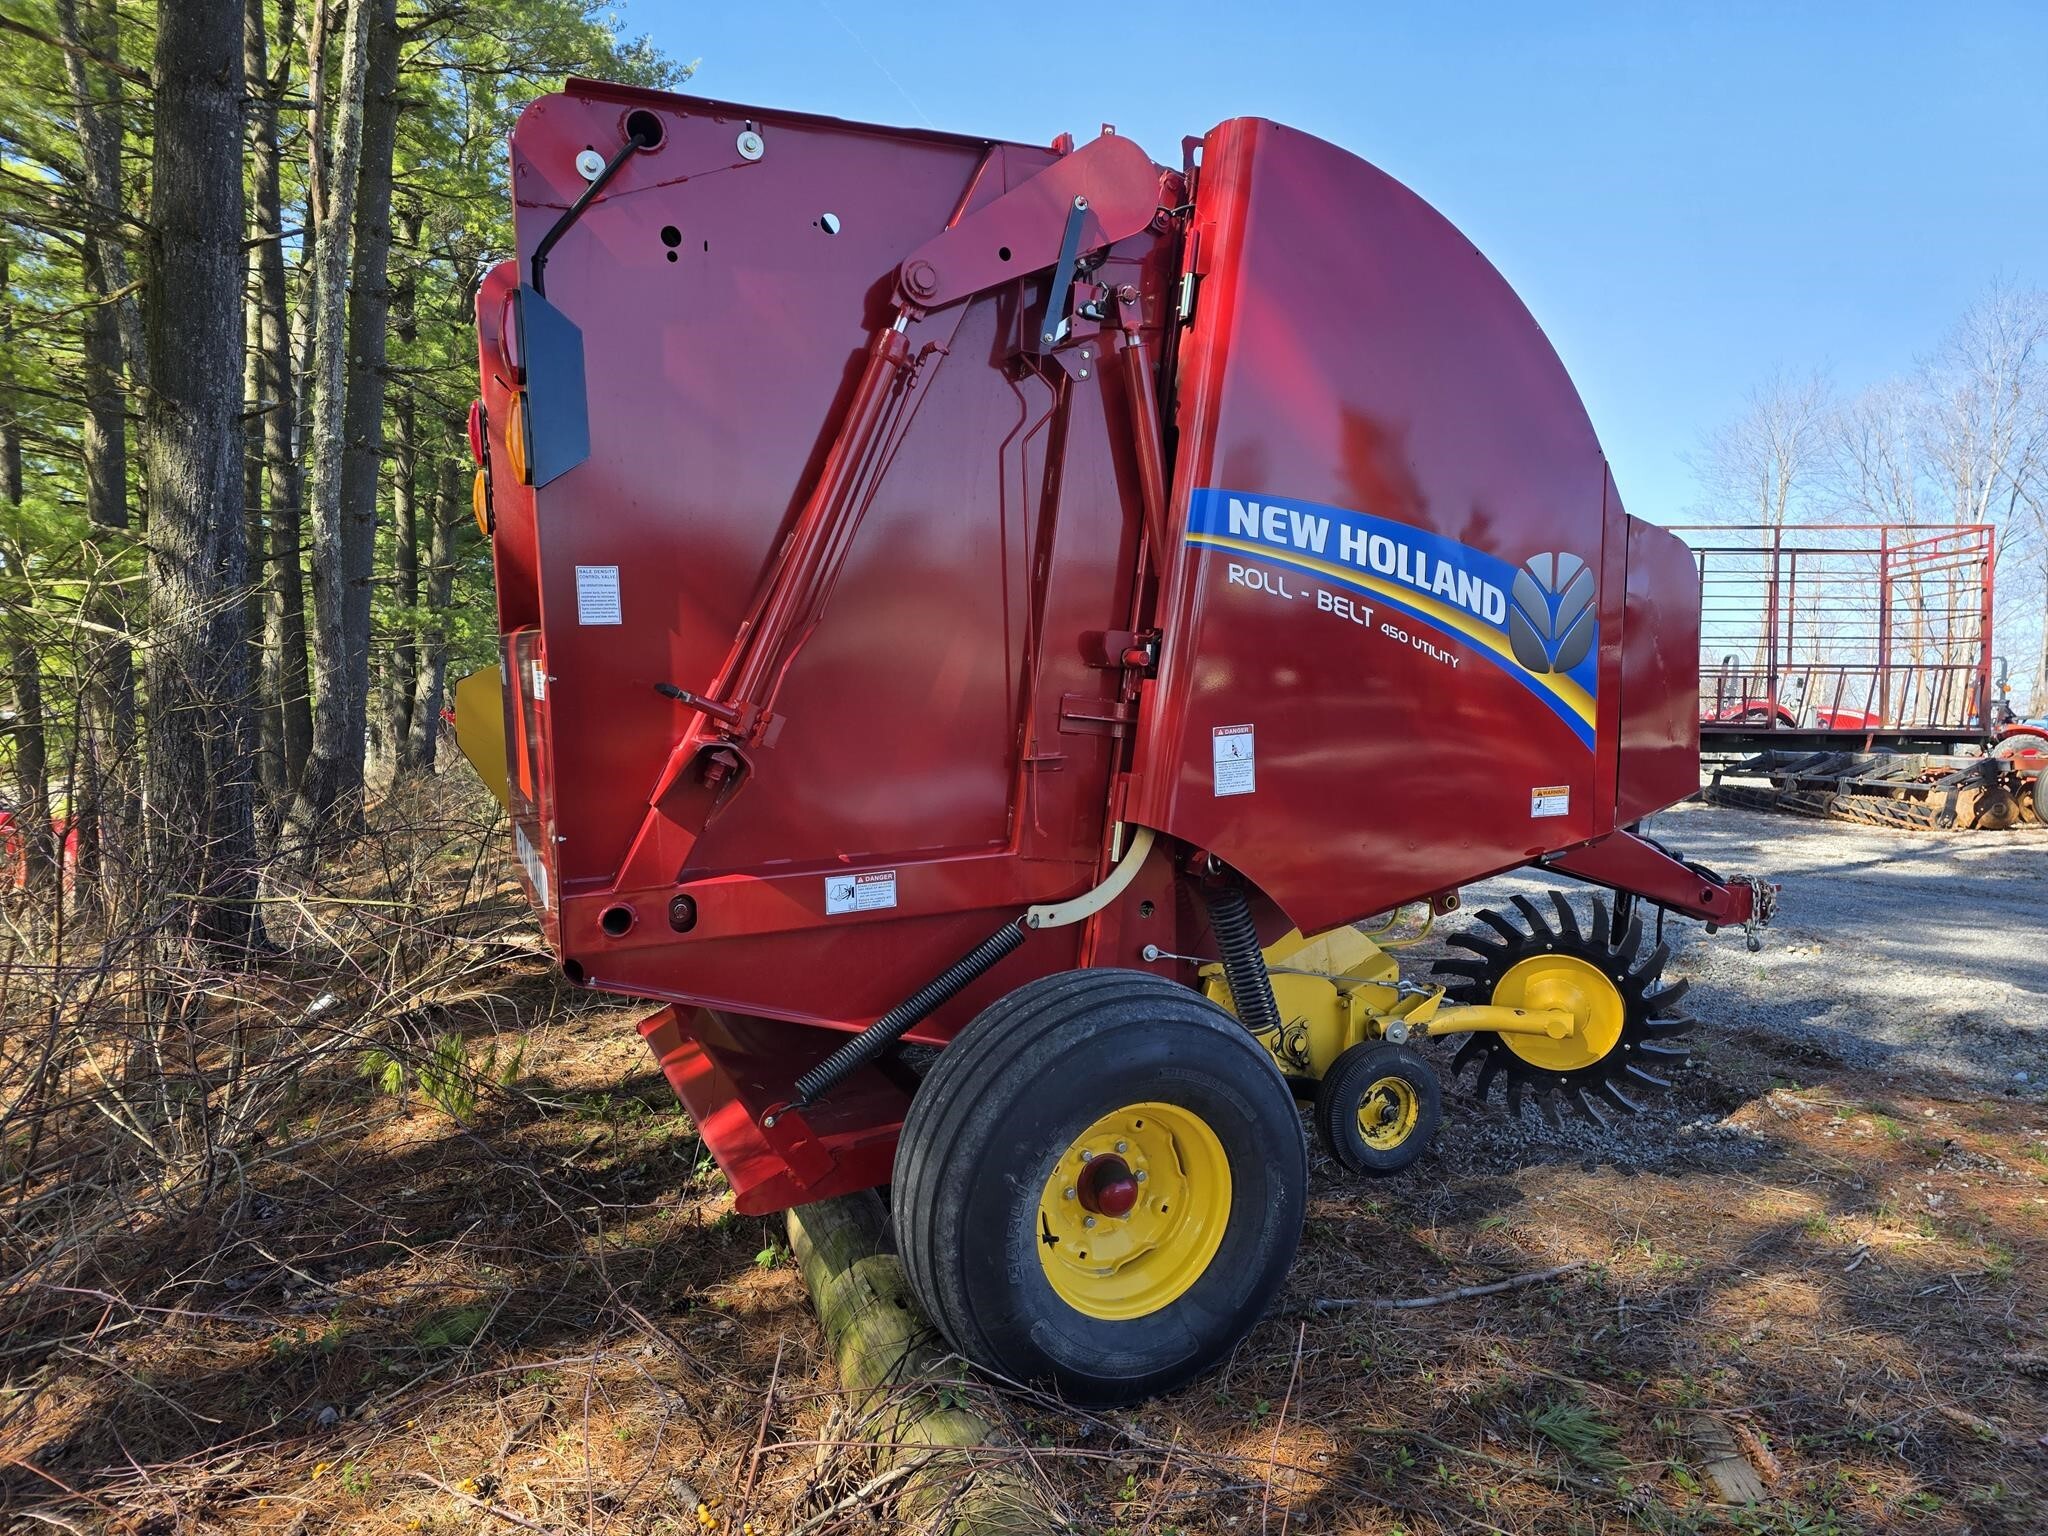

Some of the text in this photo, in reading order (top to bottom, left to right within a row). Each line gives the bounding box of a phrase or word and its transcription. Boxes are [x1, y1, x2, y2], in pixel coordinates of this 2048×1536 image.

[1228, 498, 1506, 625] NEW HOLLAND
[1228, 563, 1293, 599] ROLL
[1317, 589, 1374, 628] BELT
[1380, 622, 1408, 644] 450
[1412, 637, 1459, 668] UTILITY
[865, 874, 893, 882] DANGER
